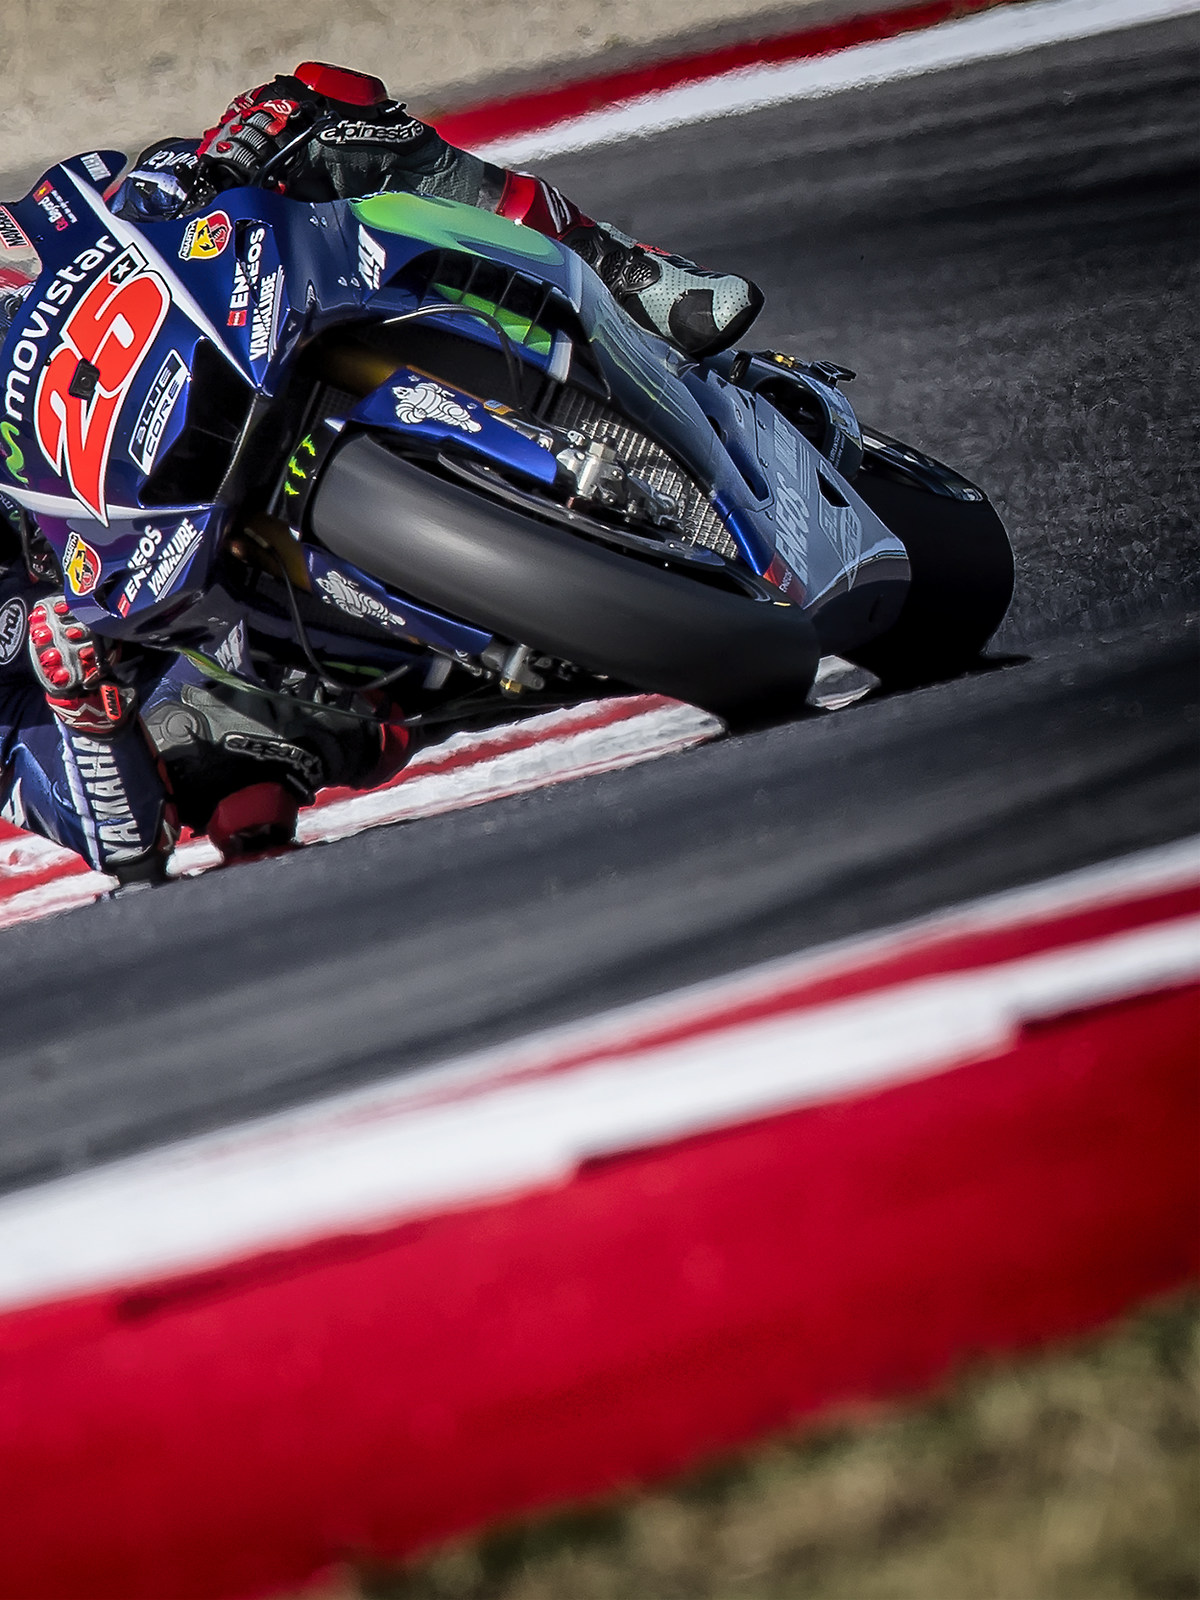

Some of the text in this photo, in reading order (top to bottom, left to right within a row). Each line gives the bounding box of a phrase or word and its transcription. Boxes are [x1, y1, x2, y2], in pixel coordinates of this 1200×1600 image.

[180, 221, 198, 258] ABARTH
[229, 228, 266, 309] ENEOS
[4, 235, 117, 421] movistar
[249, 272, 277, 362] YAMALUBE
[34, 242, 173, 528] 25
[136, 367, 172, 444] BLUE
[146, 380, 179, 457] CORE
[125, 525, 162, 603] ENEOS
[147, 518, 199, 597] YAMALUBE
